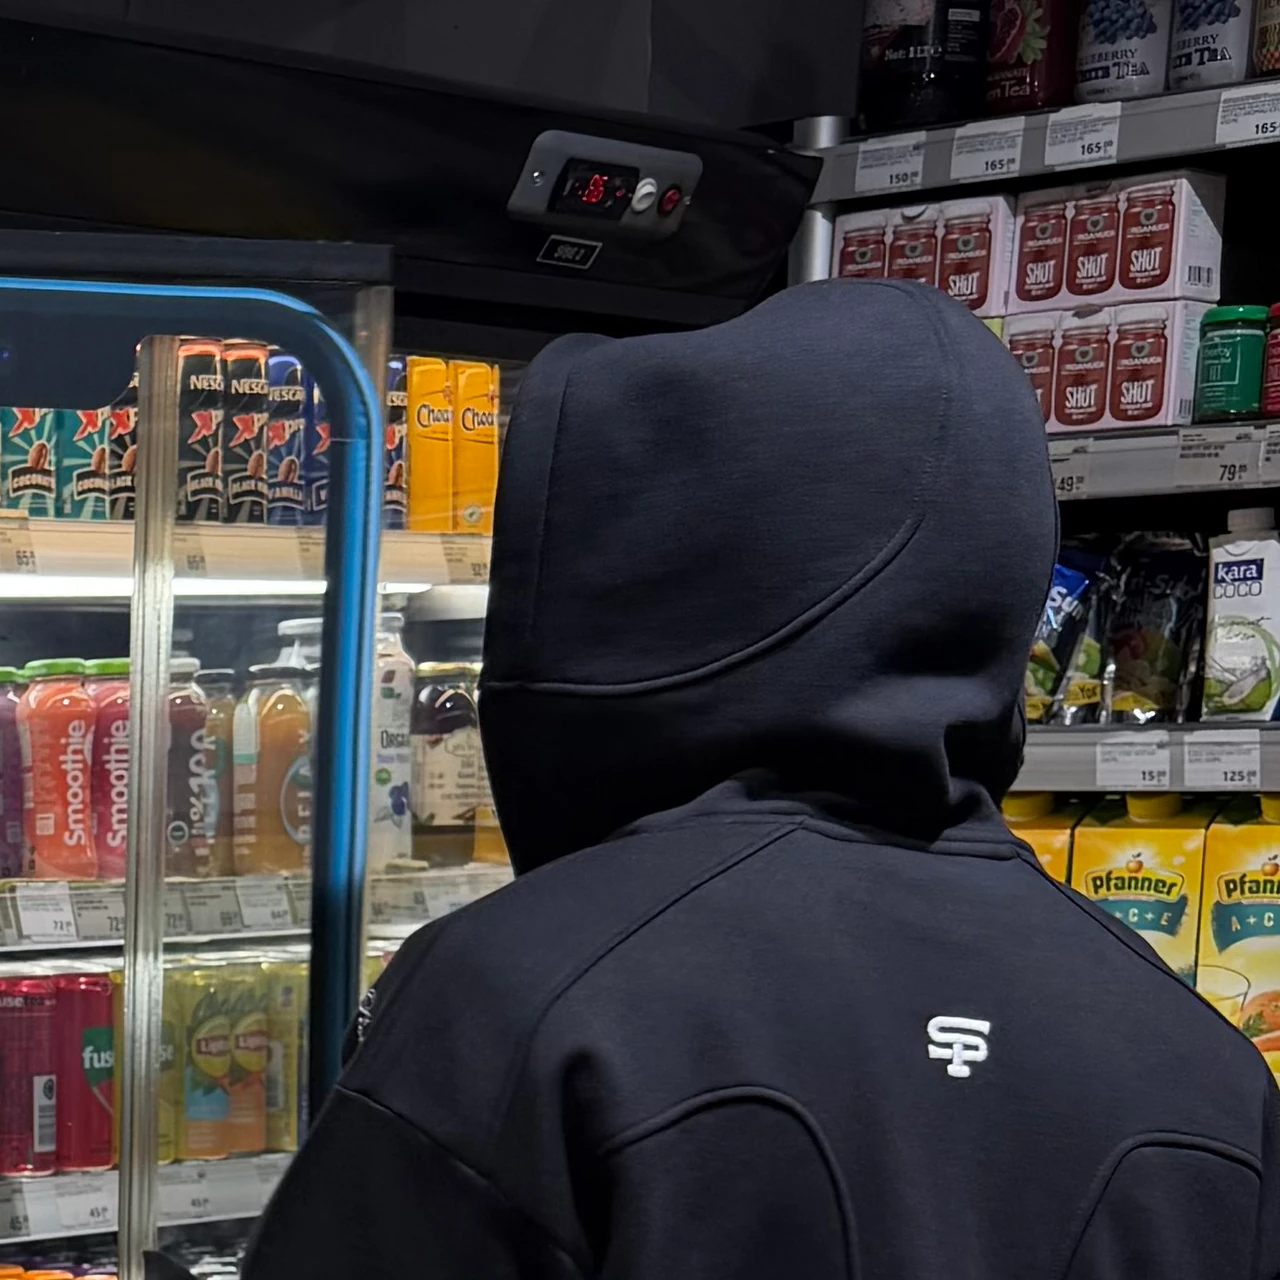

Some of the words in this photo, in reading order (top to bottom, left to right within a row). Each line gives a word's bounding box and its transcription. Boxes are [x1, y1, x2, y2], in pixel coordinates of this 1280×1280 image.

[1197, 46, 1233, 65] TEA
[1116, 61, 1150, 78] TEA
[1217, 561, 1258, 582] kara
[1213, 581, 1262, 599] COCO
[63, 719, 88, 847] Smoothie
[106, 719, 130, 847] Smoothie
[1092, 871, 1177, 894] pfanner
